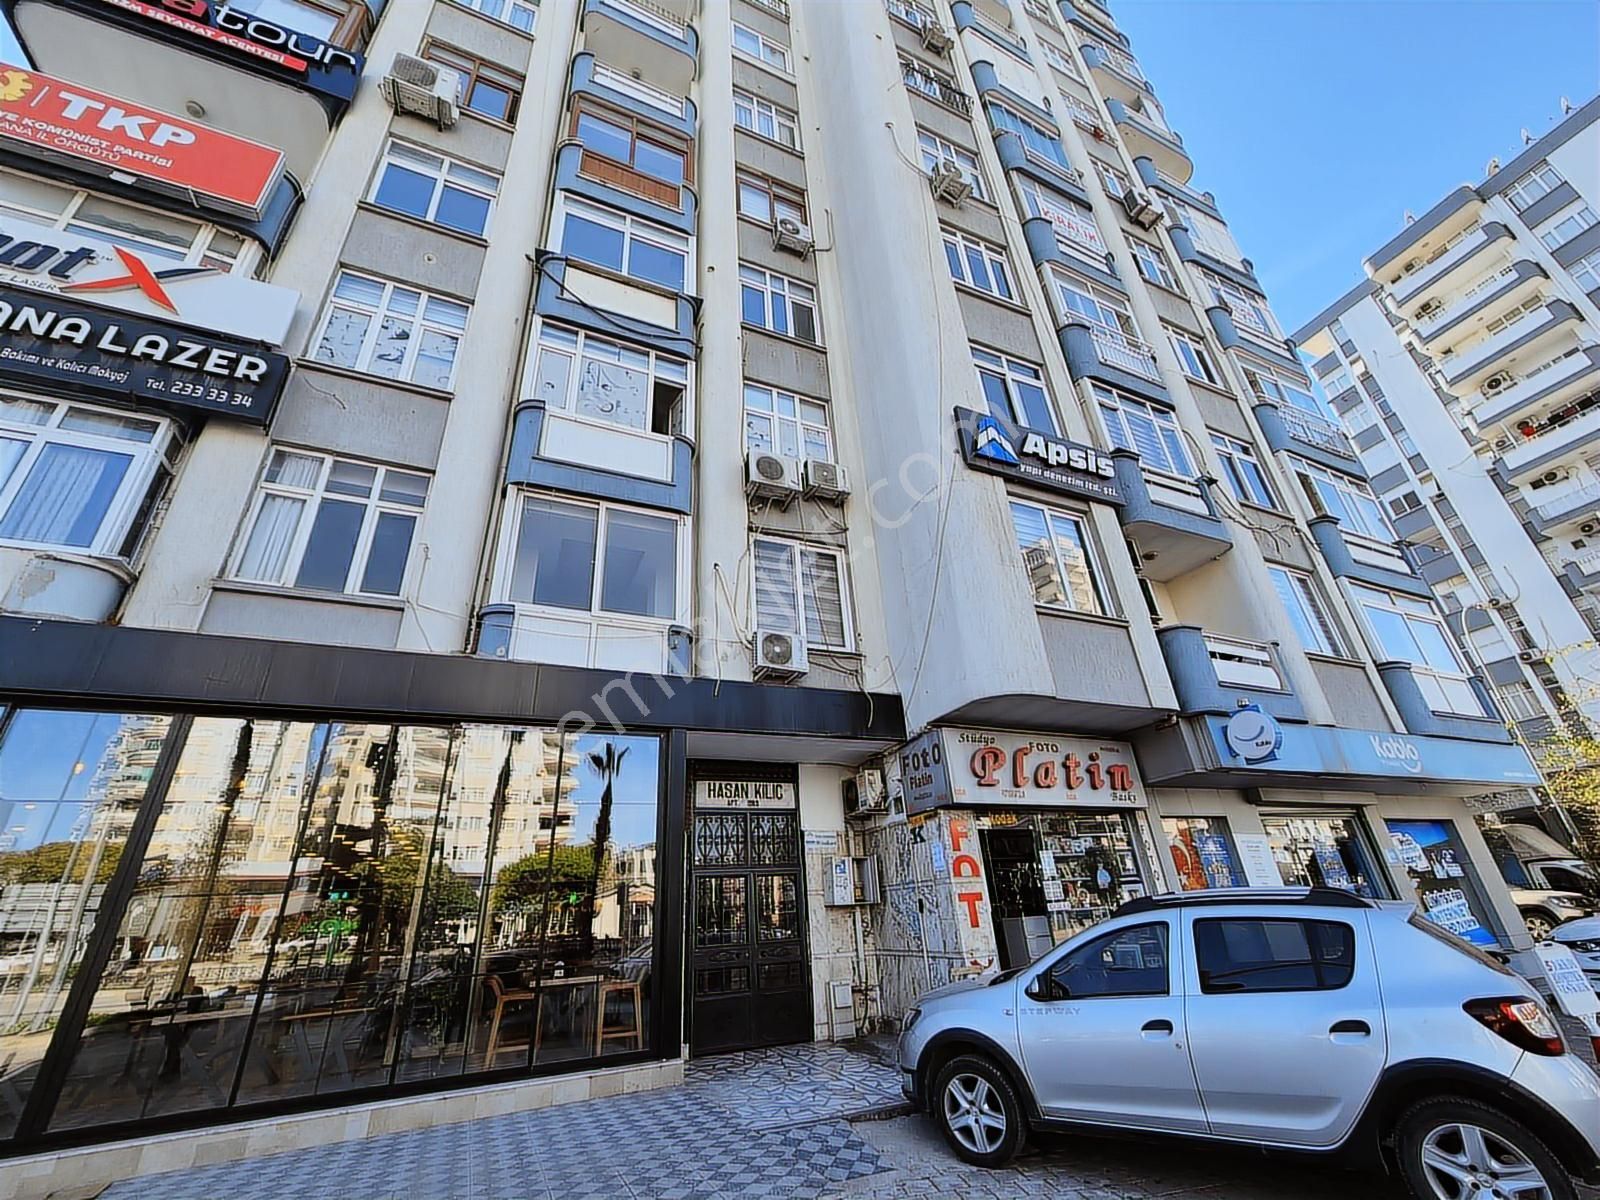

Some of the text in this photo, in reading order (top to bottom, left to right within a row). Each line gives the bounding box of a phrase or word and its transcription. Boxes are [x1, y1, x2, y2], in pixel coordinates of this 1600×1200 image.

[147, 9, 216, 38] SEYAHAT
[59, 90, 196, 147] TKP
[96, 324, 268, 384] LAZER
[146, 378, 253, 408] Tel. 233 33 34
[1022, 432, 1115, 479] Apsis
[1043, 469, 1084, 488] denetim
[1370, 734, 1420, 761] Kablo
[970, 745, 1136, 792] Platin
[707, 782, 749, 799] HASAN
